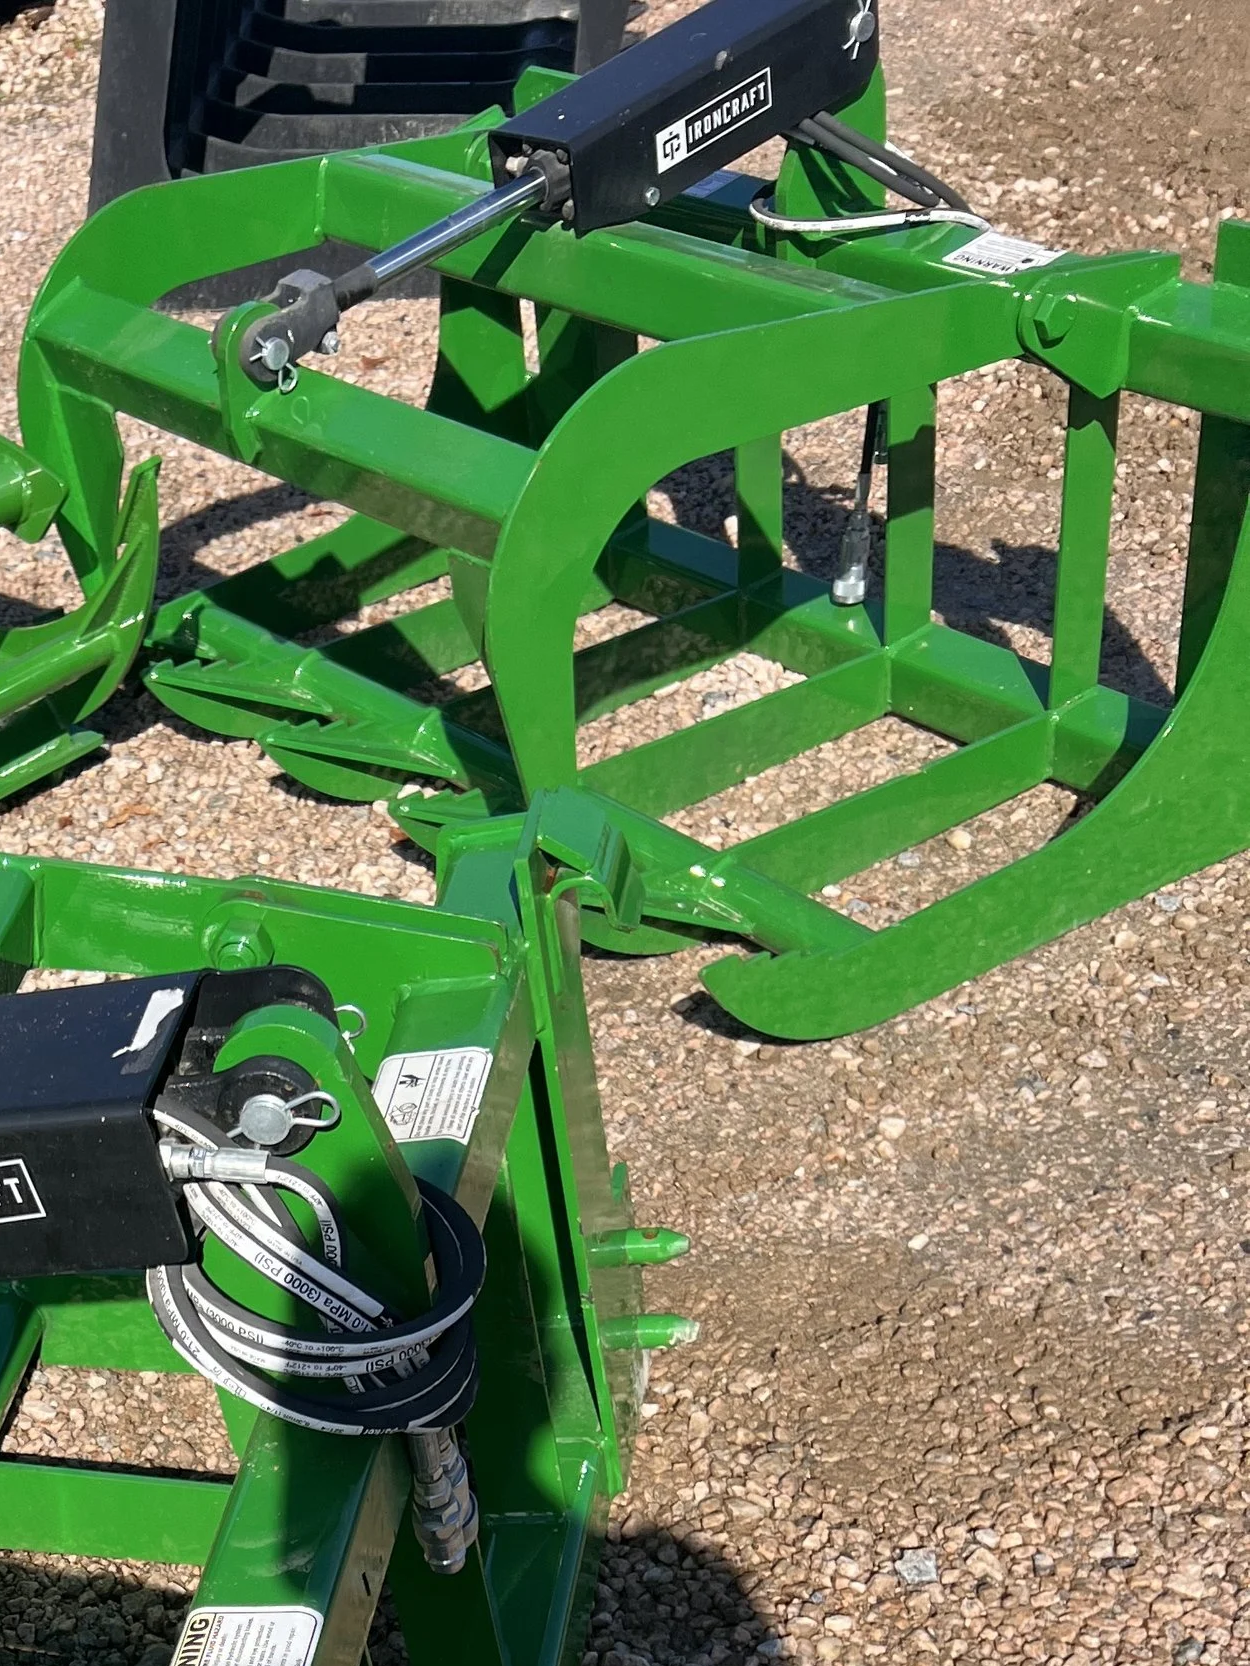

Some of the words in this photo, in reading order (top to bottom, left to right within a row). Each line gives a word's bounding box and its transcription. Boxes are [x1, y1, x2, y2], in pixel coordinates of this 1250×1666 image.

[688, 82, 766, 143] IRONCRAFT
[953, 254, 1010, 272] WARNING
[254, 1251, 284, 1278] PSI)
[284, 1272, 322, 1304] (3000
[324, 1299, 351, 1322] MPa
[365, 1355, 395, 1372] PSI)
[212, 1616, 225, 1639] HAZARD
